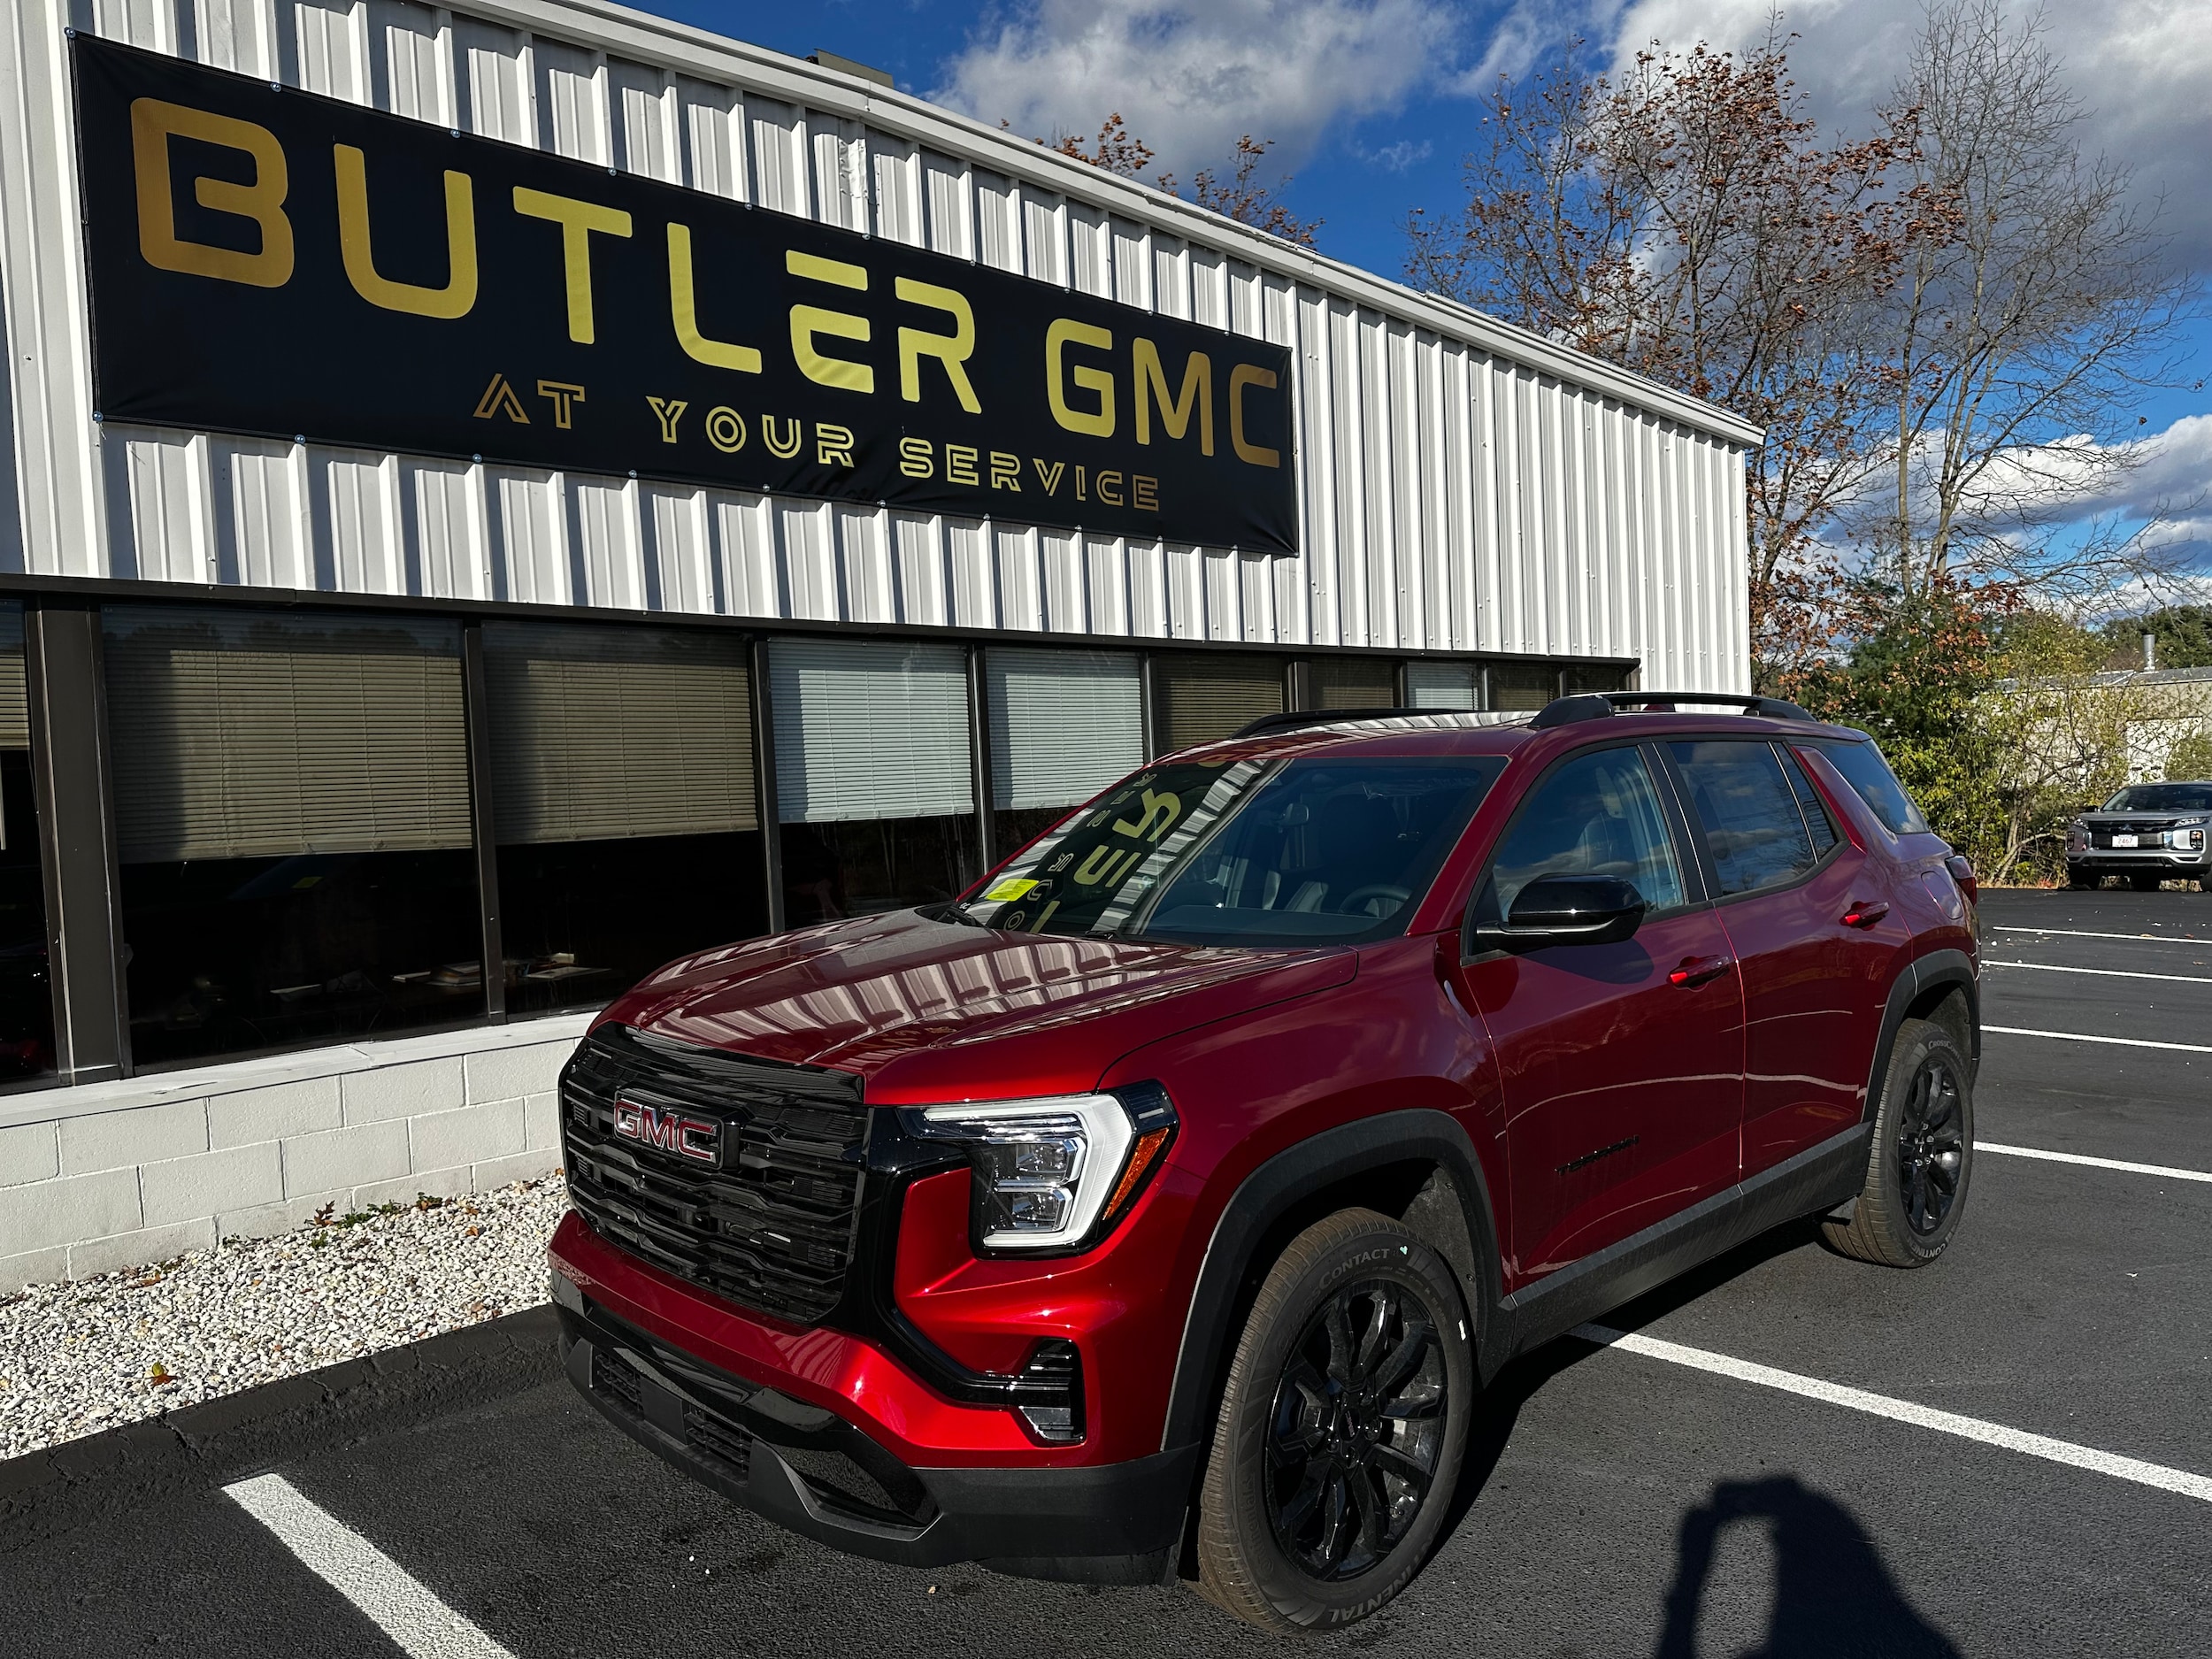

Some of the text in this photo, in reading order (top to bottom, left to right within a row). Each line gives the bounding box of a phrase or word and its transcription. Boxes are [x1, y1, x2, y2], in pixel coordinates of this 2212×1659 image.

[130, 97, 1280, 468] BUTLER GMC
[473, 373, 1160, 512] AT YOUR SERVICE
[614, 1097, 718, 1164] GMC
